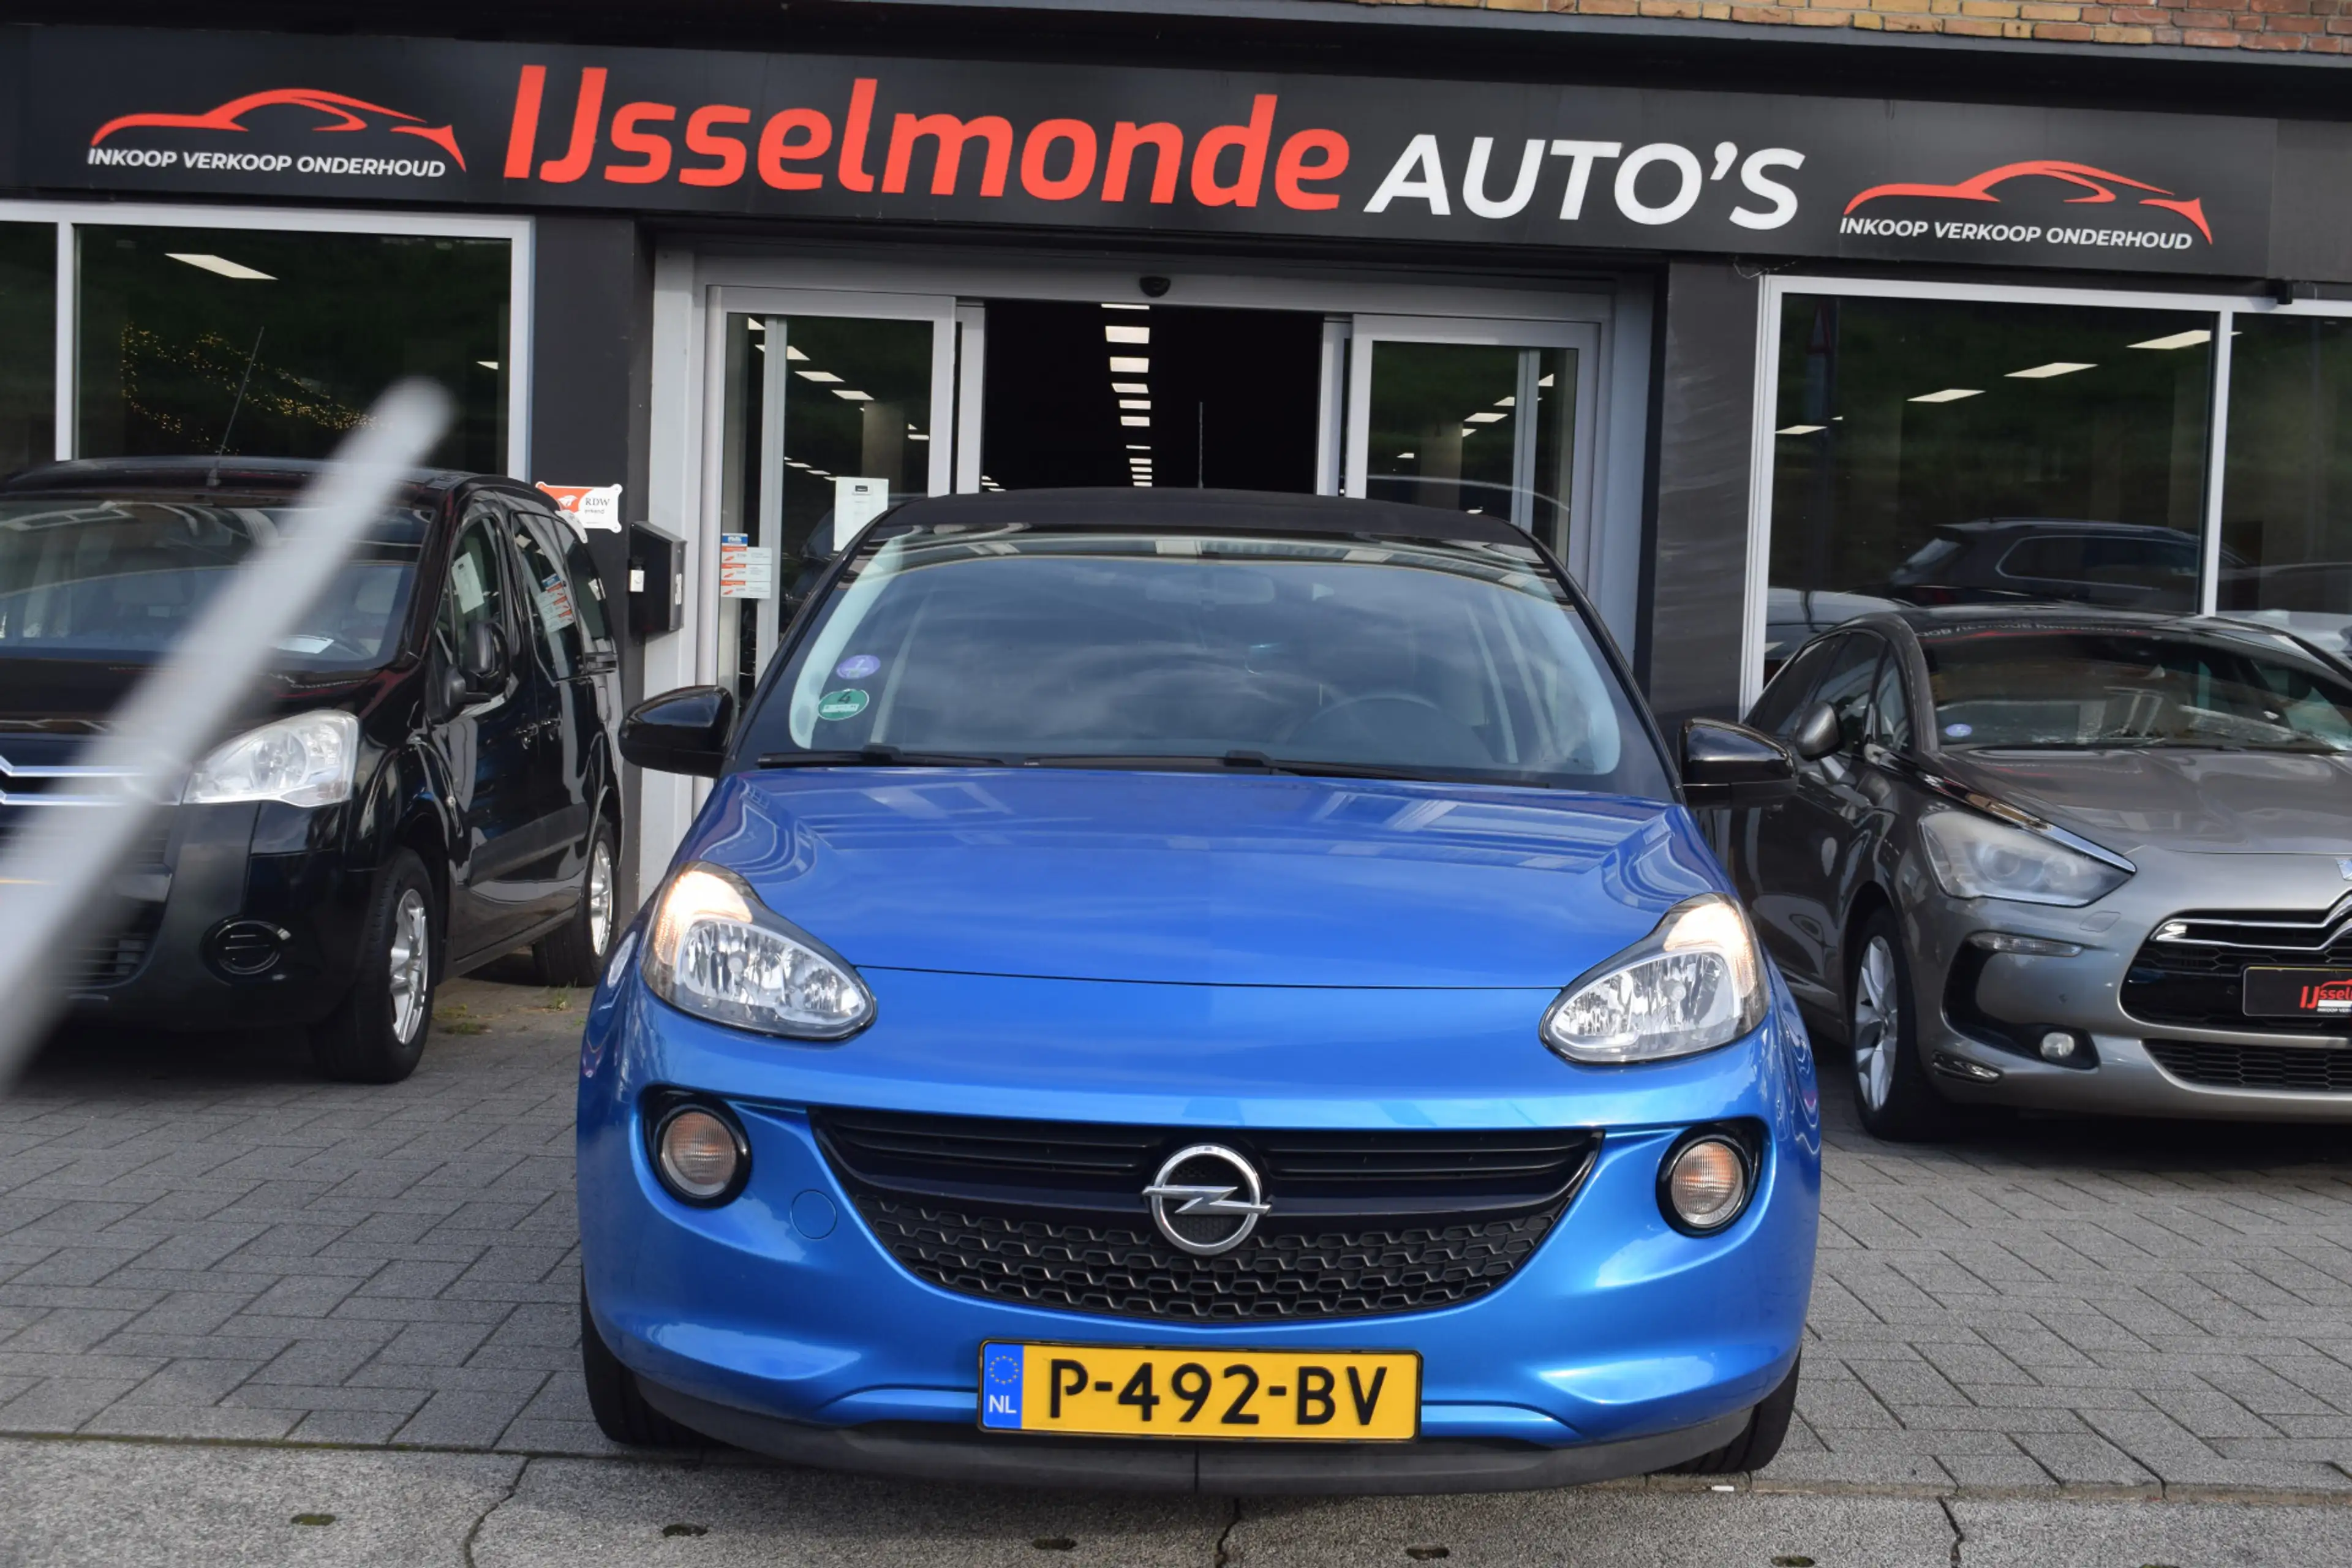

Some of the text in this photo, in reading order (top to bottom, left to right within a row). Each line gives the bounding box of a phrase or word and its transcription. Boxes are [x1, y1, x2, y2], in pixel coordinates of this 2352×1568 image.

[503, 64, 1806, 231] IJsselmonde AUTO'S
[88, 148, 446, 178] INKOOP VERKOOP ONDERHOUD
[1839, 217, 2193, 250] INKOOP VERKOOP ONDERHOUD
[585, 497, 610, 507] RDW
[2300, 986, 2352, 1009] IJssel
[989, 1395, 1017, 1414] NL
[1050, 1359, 1387, 1426] P-492-BV
